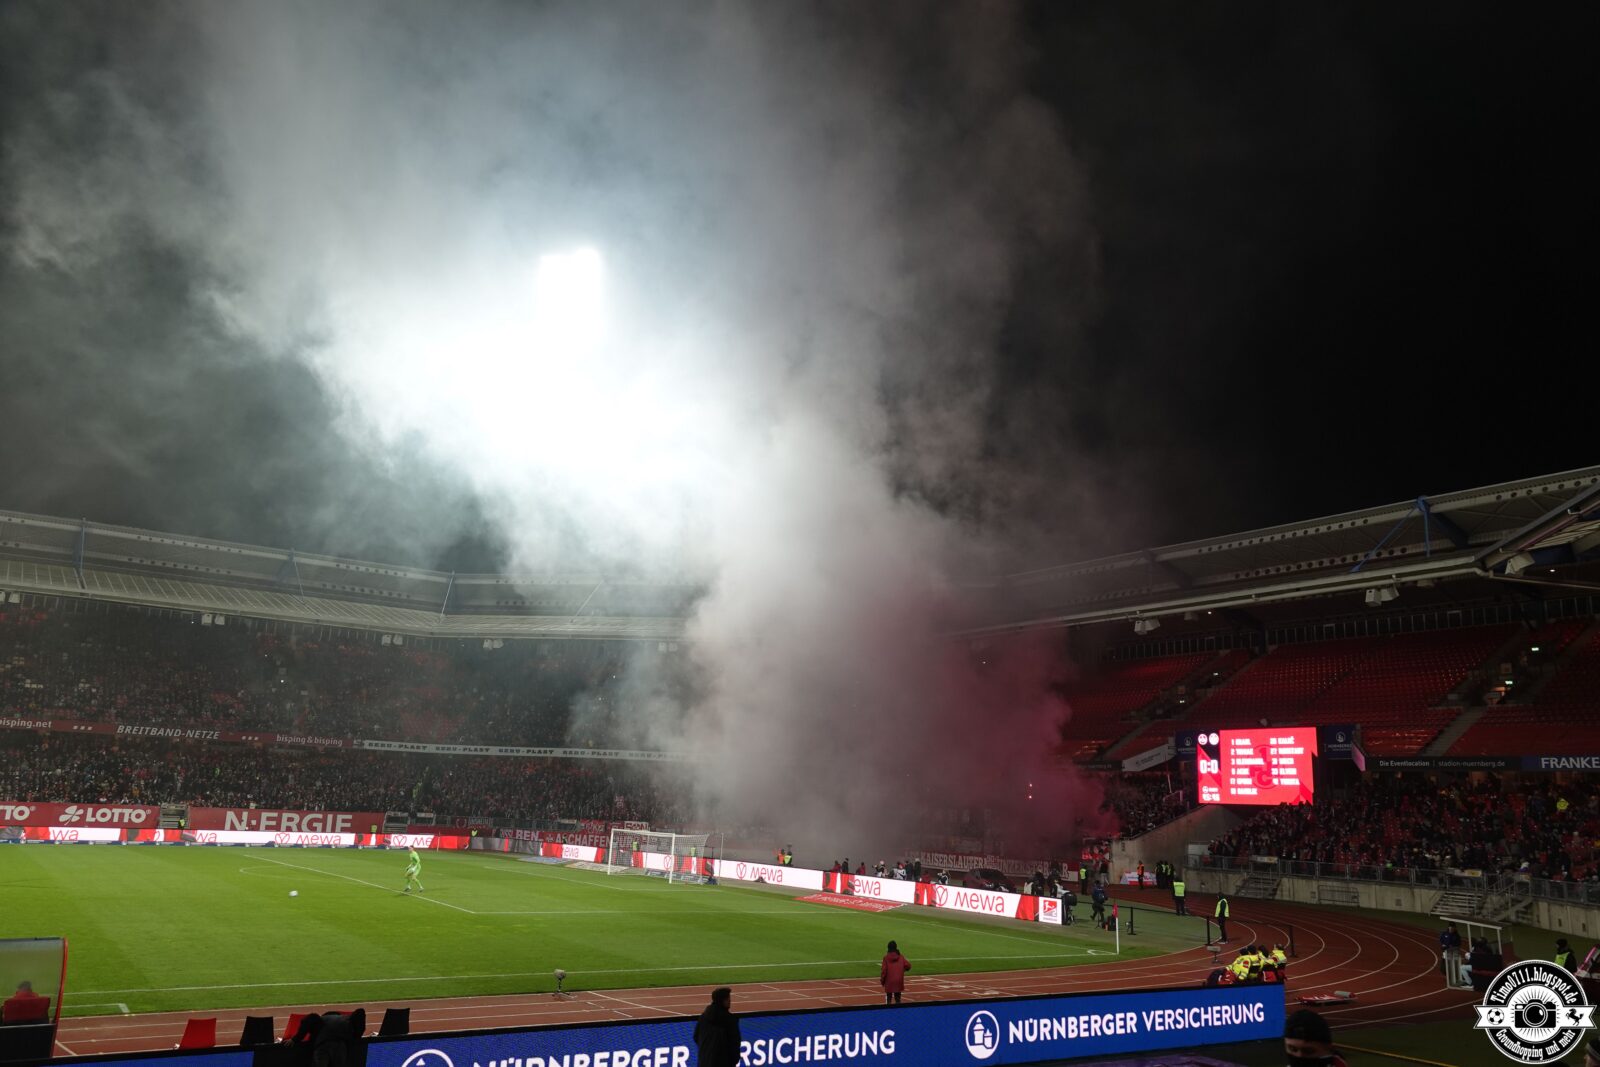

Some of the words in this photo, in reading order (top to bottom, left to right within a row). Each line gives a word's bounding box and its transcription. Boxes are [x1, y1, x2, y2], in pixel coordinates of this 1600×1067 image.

[117, 725, 220, 739] BREITBAND-NETZE
[276, 734, 306, 744] bisping
[314, 738, 343, 746] bisping
[1009, 1011, 1137, 1044] NÜRNBERGER
[1142, 1003, 1265, 1032] VERSICHERUNG
[737, 1029, 896, 1067] RSICHERUNG
